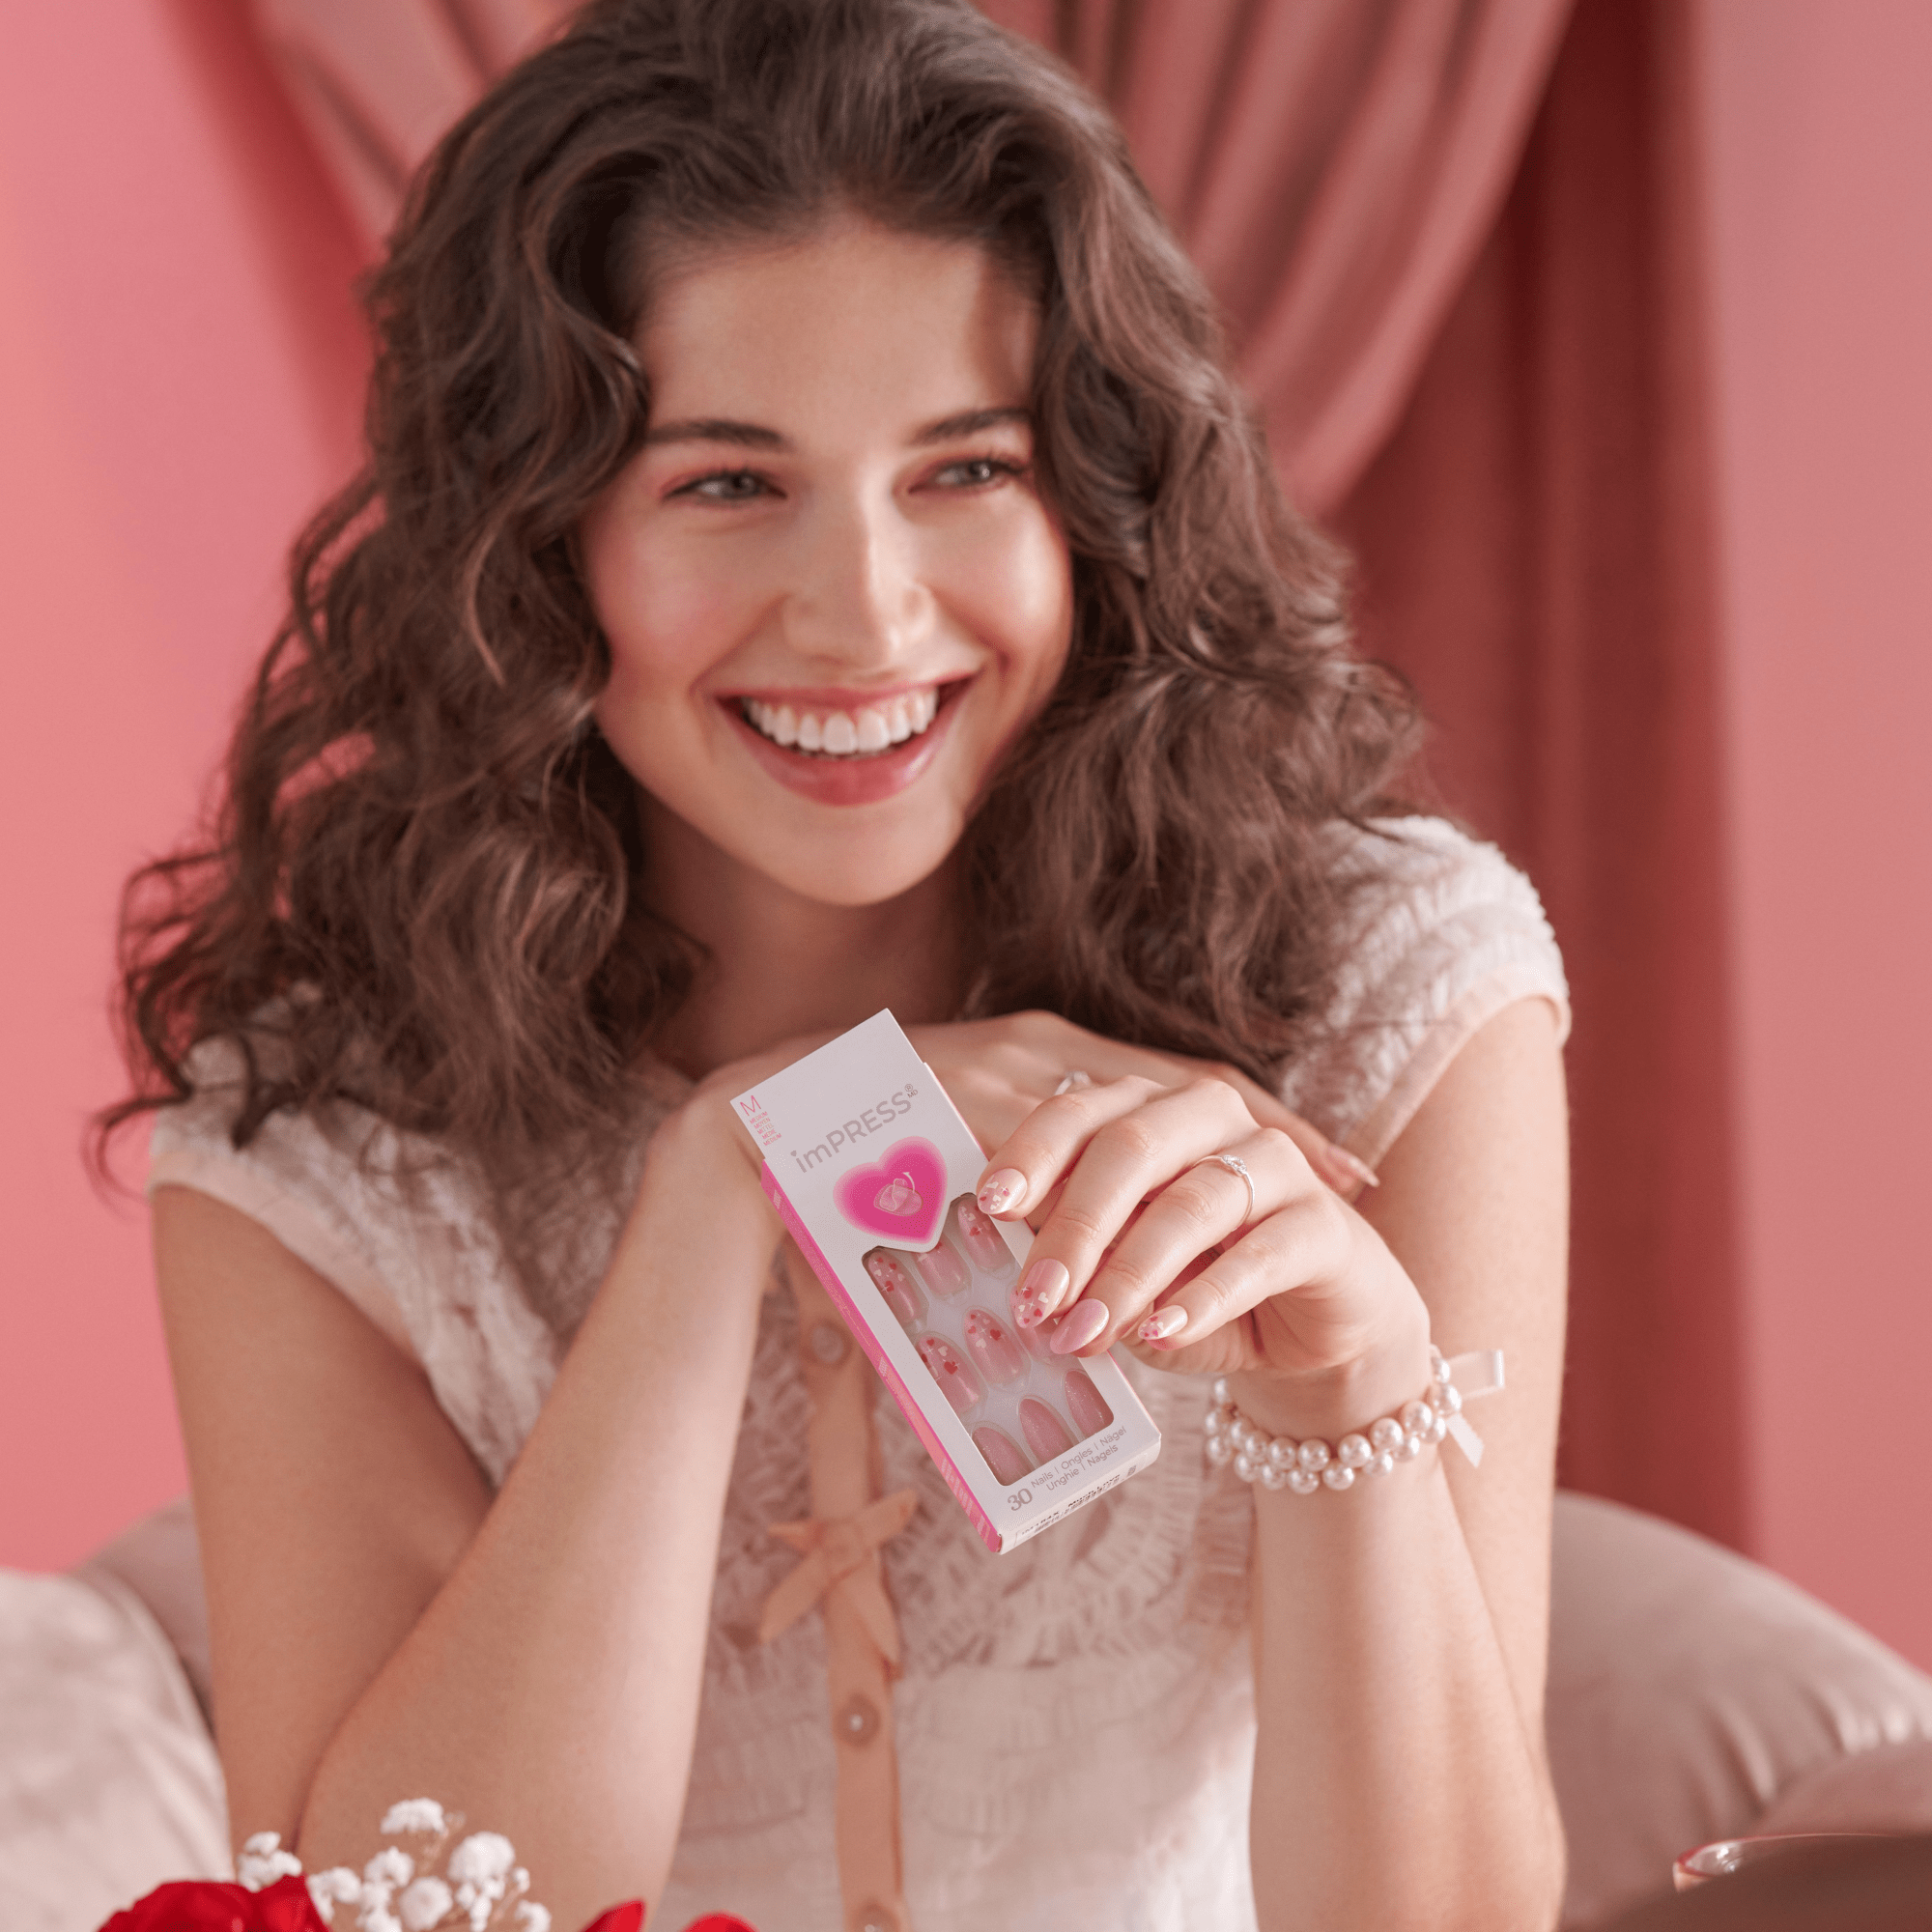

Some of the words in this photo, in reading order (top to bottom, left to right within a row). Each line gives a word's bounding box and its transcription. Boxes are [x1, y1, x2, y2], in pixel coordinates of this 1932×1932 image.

[740, 1095, 761, 1116] M
[1030, 1471, 1054, 1489] Nails
[1061, 1448, 1094, 1470] Ongles
[1099, 1426, 1127, 1447] Nägel
[1045, 1468, 1080, 1492] Unghie
[1087, 1443, 1119, 1467] Nagels
[1008, 1488, 1033, 1512] 30
